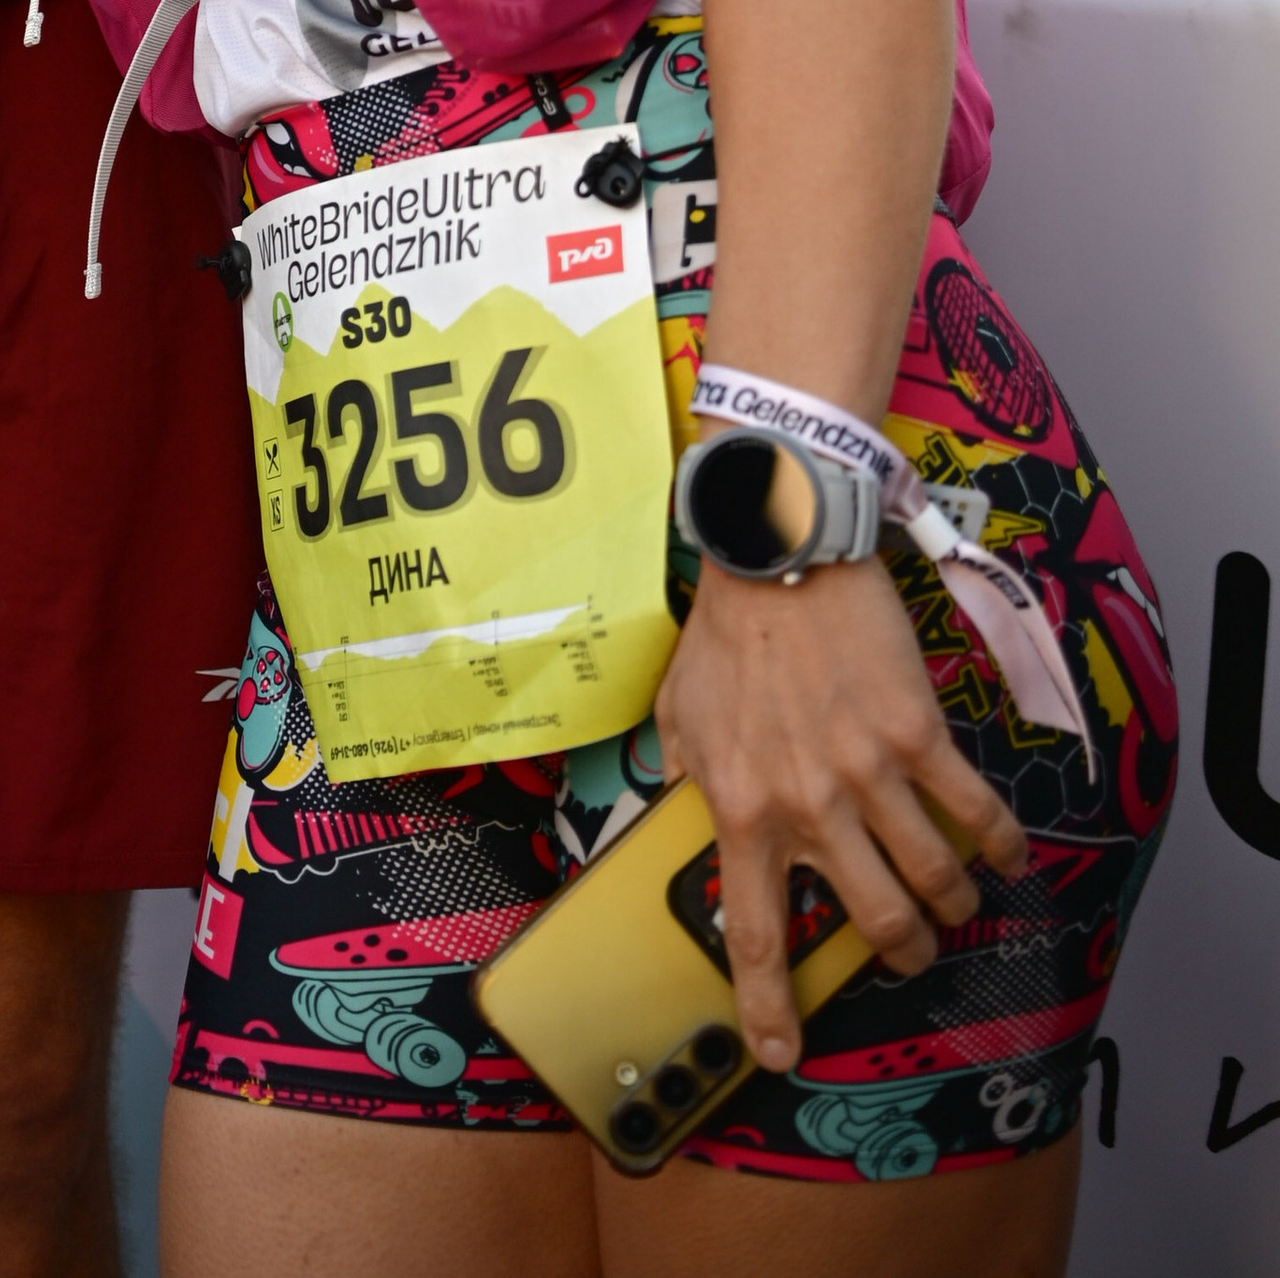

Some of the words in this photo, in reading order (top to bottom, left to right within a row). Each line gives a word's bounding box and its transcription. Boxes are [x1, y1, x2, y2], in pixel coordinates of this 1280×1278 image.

[257, 163, 546, 272] WhiteBrideUltra
[286, 217, 482, 303] Gelendzhik
[340, 296, 412, 349] S30
[283, 346, 568, 540] 3256
[730, 388, 897, 486] Gelendzhik
[368, 546, 450, 606] ДИНА
